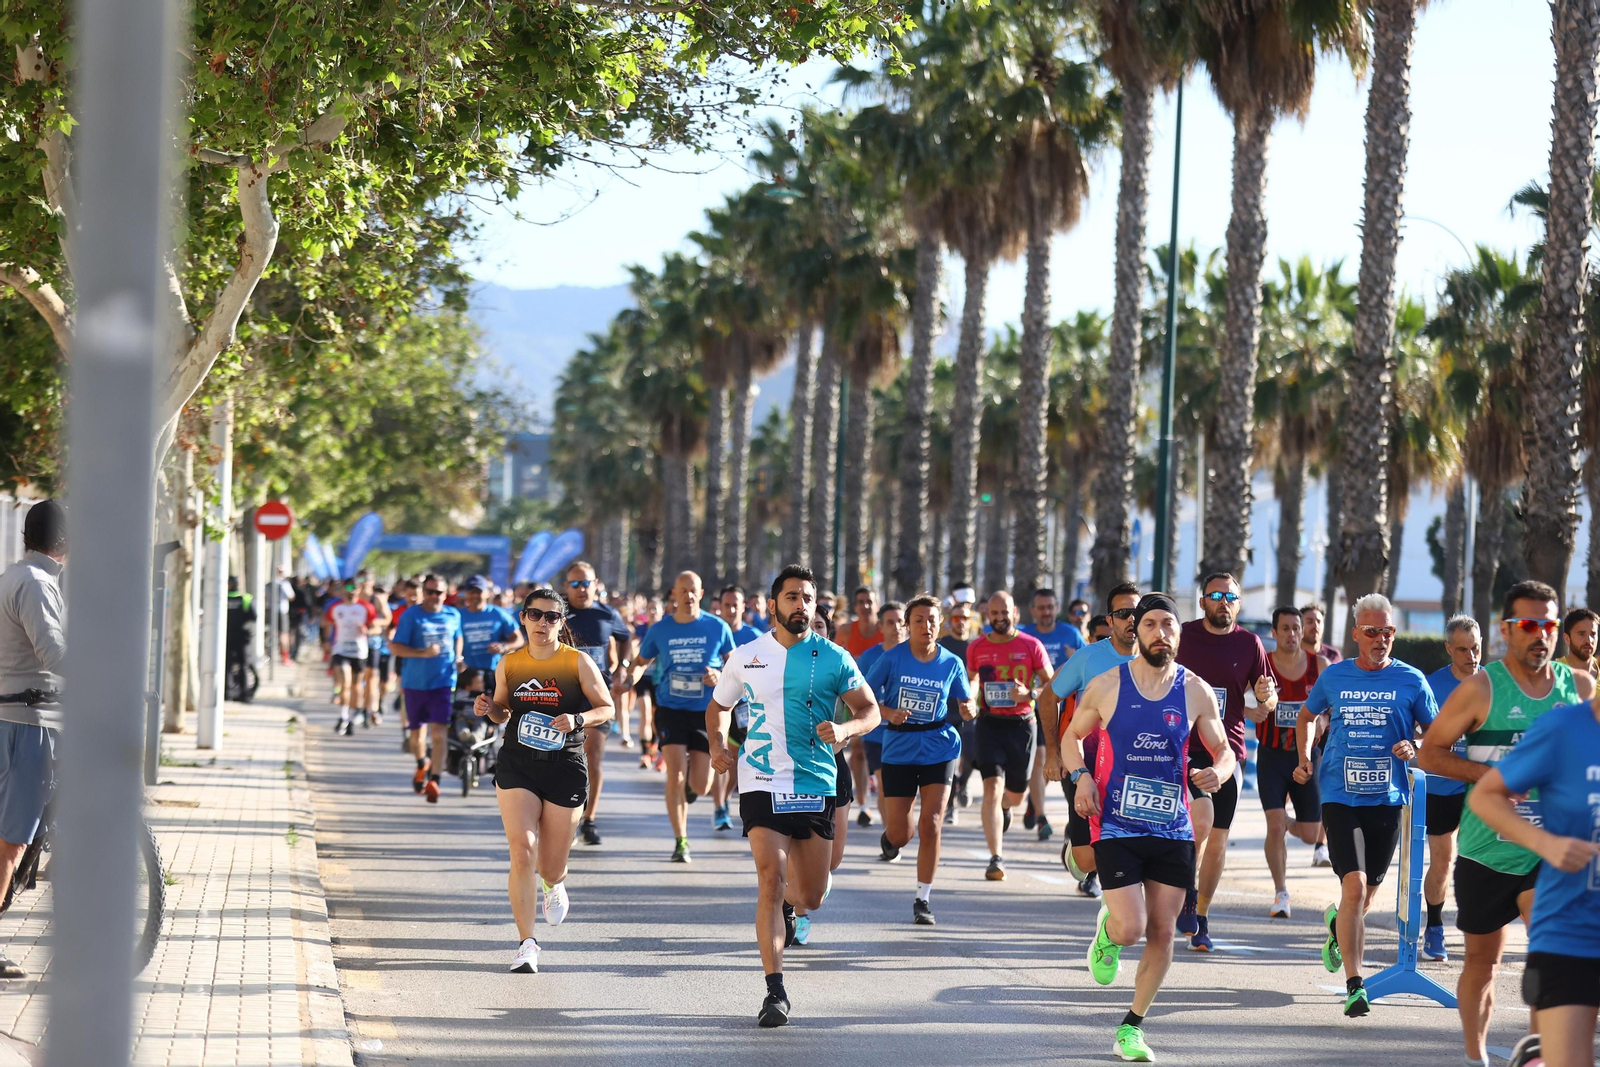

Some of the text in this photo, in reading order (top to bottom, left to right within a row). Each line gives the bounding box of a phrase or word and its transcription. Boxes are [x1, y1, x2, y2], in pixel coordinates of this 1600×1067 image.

[668, 636, 707, 646] mayoral
[900, 675, 944, 689] mayoral
[1340, 690, 1397, 702] mayoral
[903, 700, 932, 711] 1769
[525, 724, 560, 740] 1917
[1133, 732, 1169, 750] Ford
[1126, 753, 1174, 763] Garum Motor
[1351, 771, 1387, 782] 1666
[1130, 793, 1173, 811] 1729
